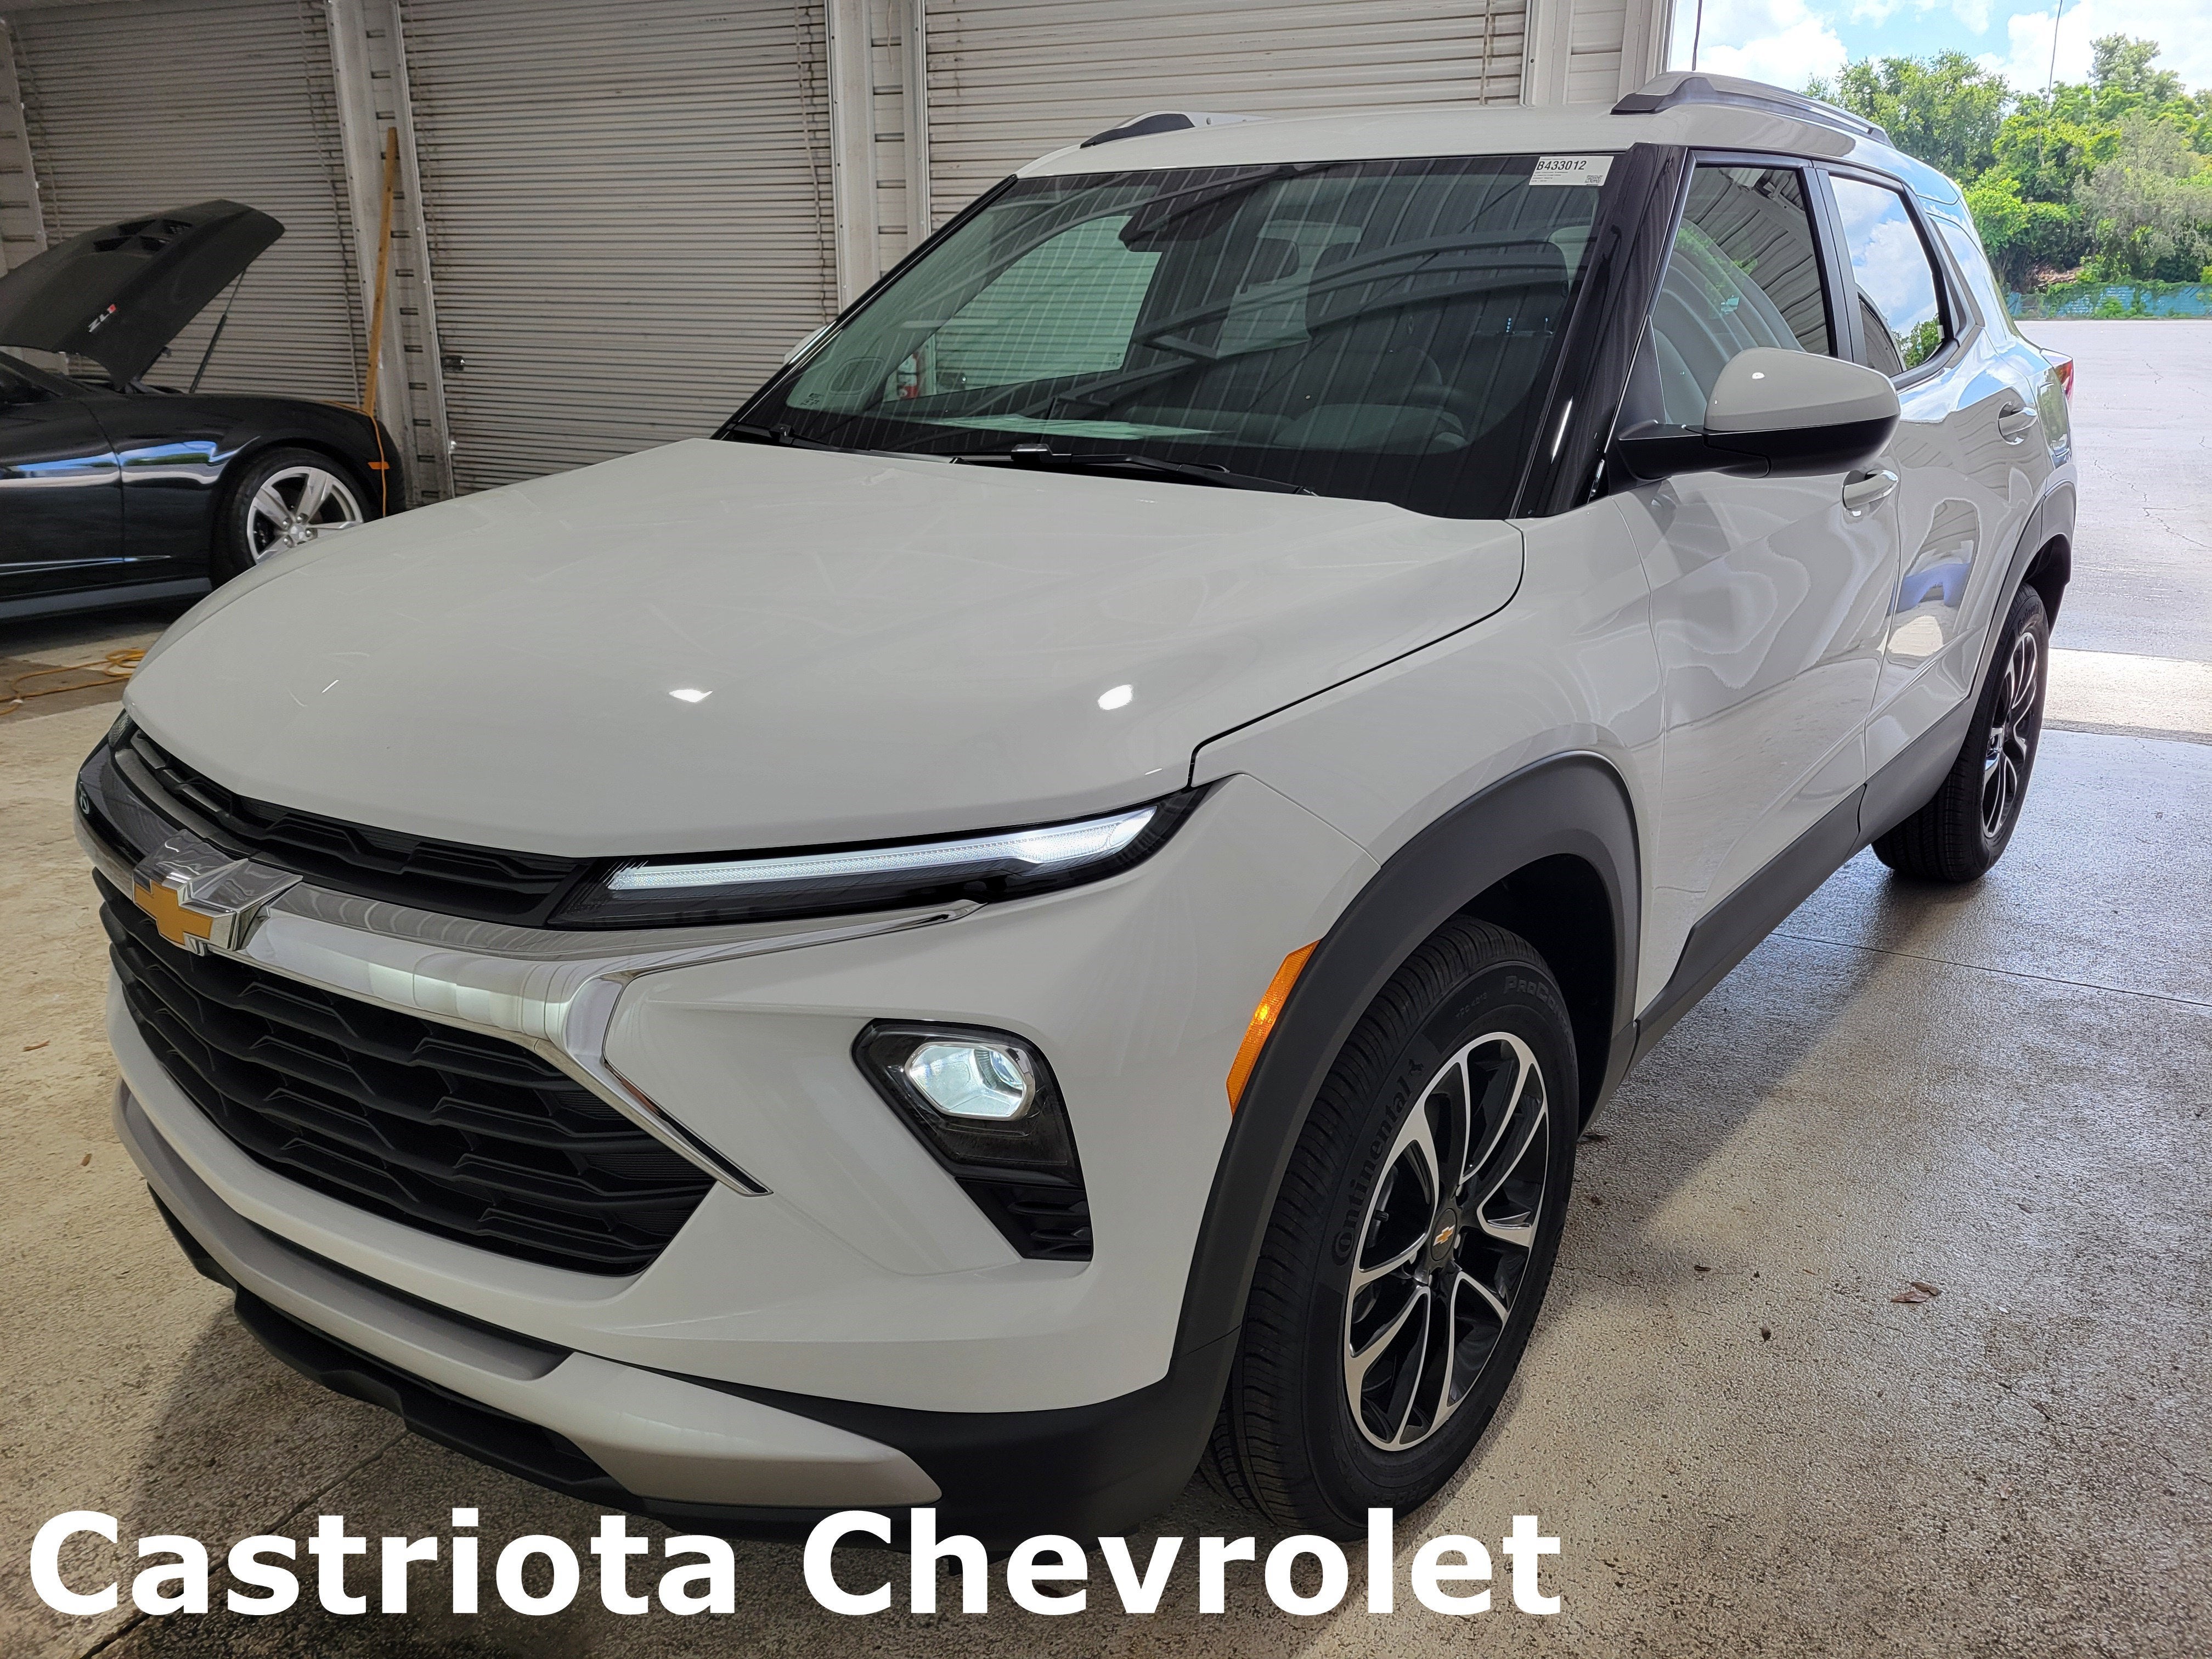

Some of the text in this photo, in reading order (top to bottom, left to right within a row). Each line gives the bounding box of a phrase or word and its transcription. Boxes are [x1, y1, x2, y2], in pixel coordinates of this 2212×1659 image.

[1536, 160, 1587, 171] B433012
[87, 303, 117, 333] ZL1
[1331, 1075, 1412, 1266] Continental
